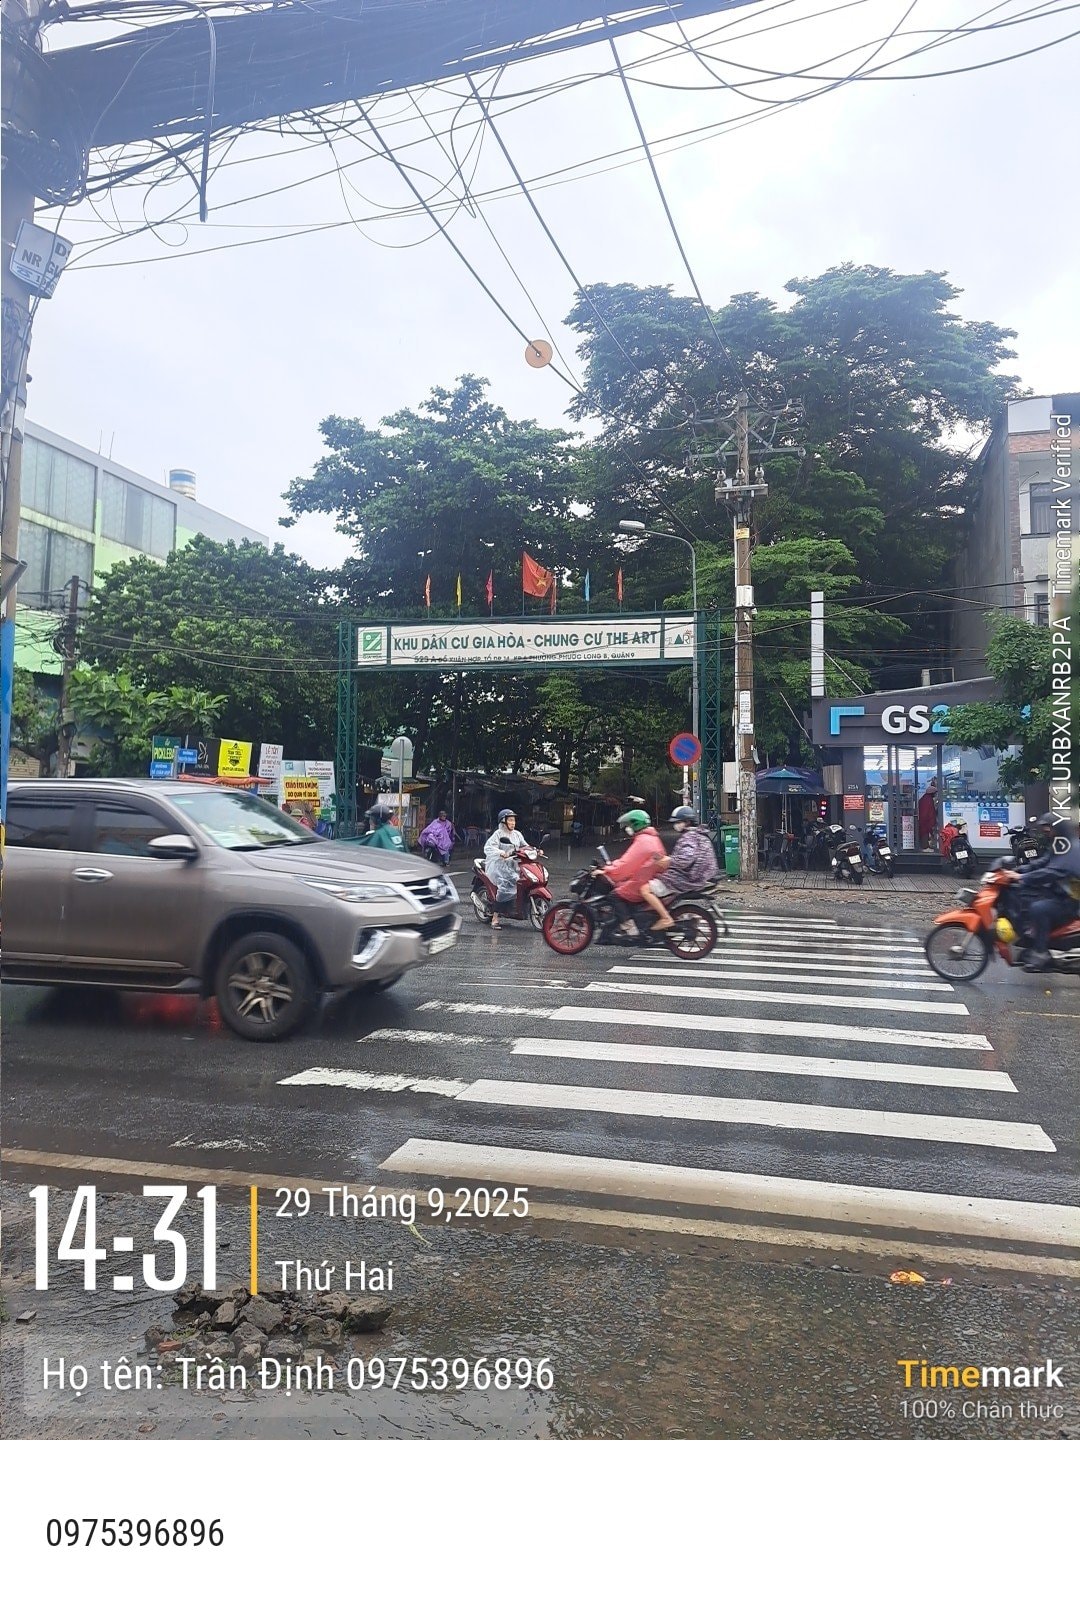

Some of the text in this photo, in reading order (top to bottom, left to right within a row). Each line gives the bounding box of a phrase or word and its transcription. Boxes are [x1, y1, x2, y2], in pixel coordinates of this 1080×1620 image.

[21, 249, 43, 268] NR
[394, 637, 418, 650] KHU
[421, 634, 448, 650] DÂN
[451, 635, 470, 649] CƯ
[472, 636, 495, 649] GIA
[497, 632, 525, 648] HÒA
[534, 633, 579, 648] CHUNG
[583, 631, 604, 646] CƯ
[606, 631, 629, 646] THE
[632, 630, 658, 645] ART
[583, 652, 602, 660] LONG
